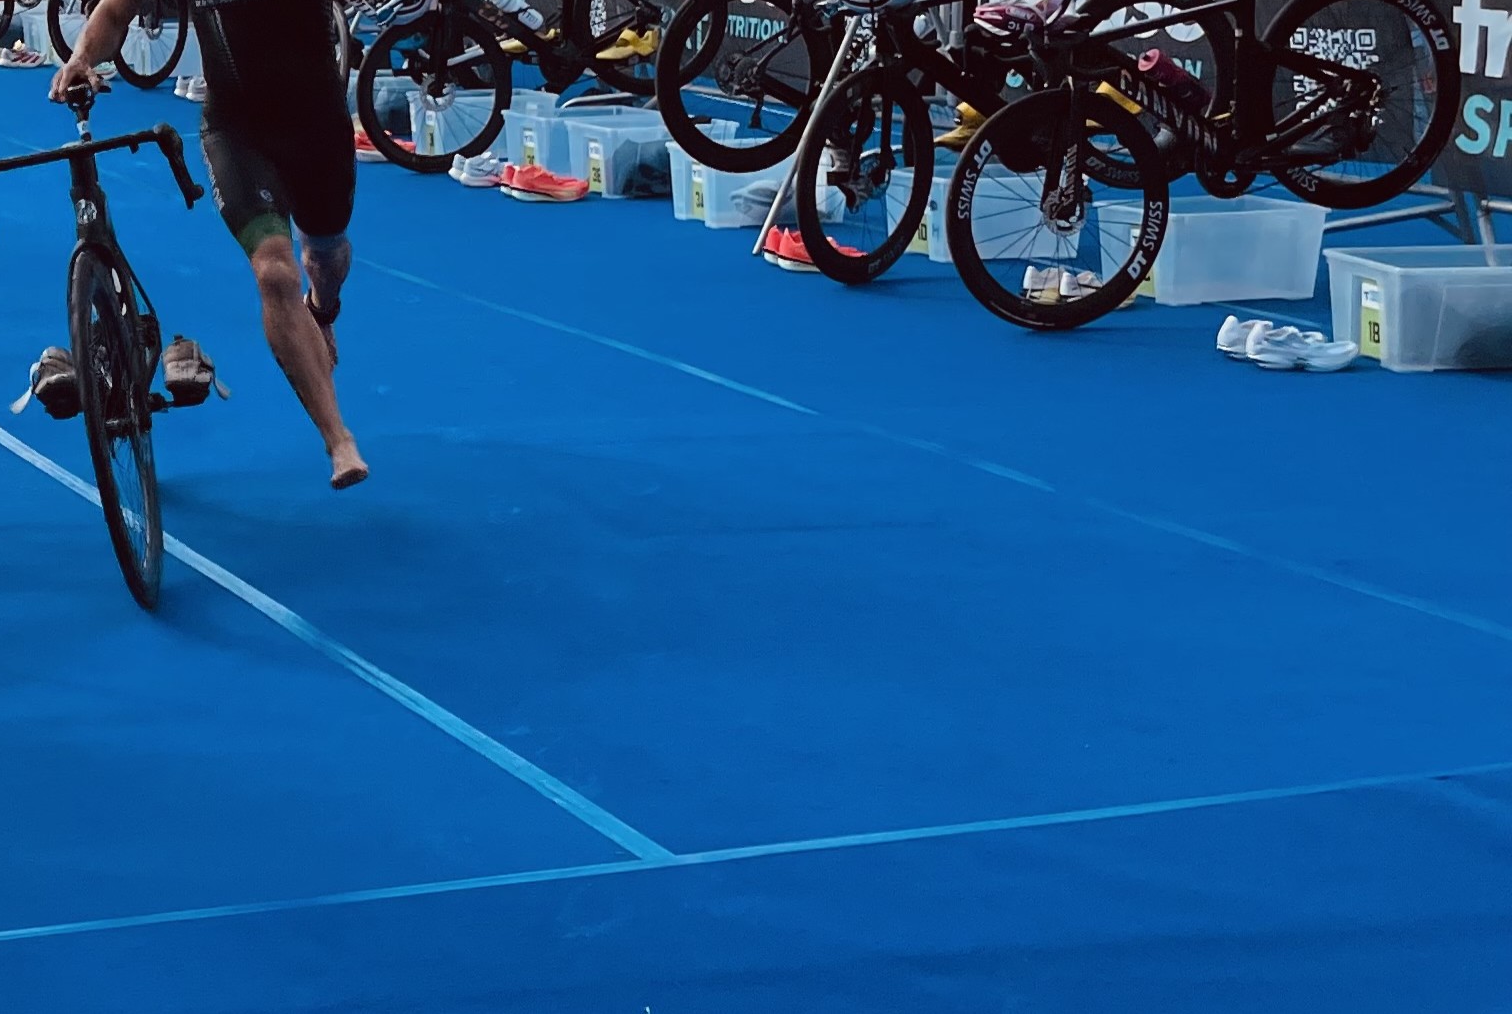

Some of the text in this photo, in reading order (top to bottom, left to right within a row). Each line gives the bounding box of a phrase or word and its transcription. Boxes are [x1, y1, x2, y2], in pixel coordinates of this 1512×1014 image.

[725, 13, 786, 43] TRITION
[1288, 166, 1320, 192] WISS
[957, 169, 977, 220] SWISS
[1126, 200, 1163, 280] DT SWISS
[1368, 320, 1381, 344] 1B
